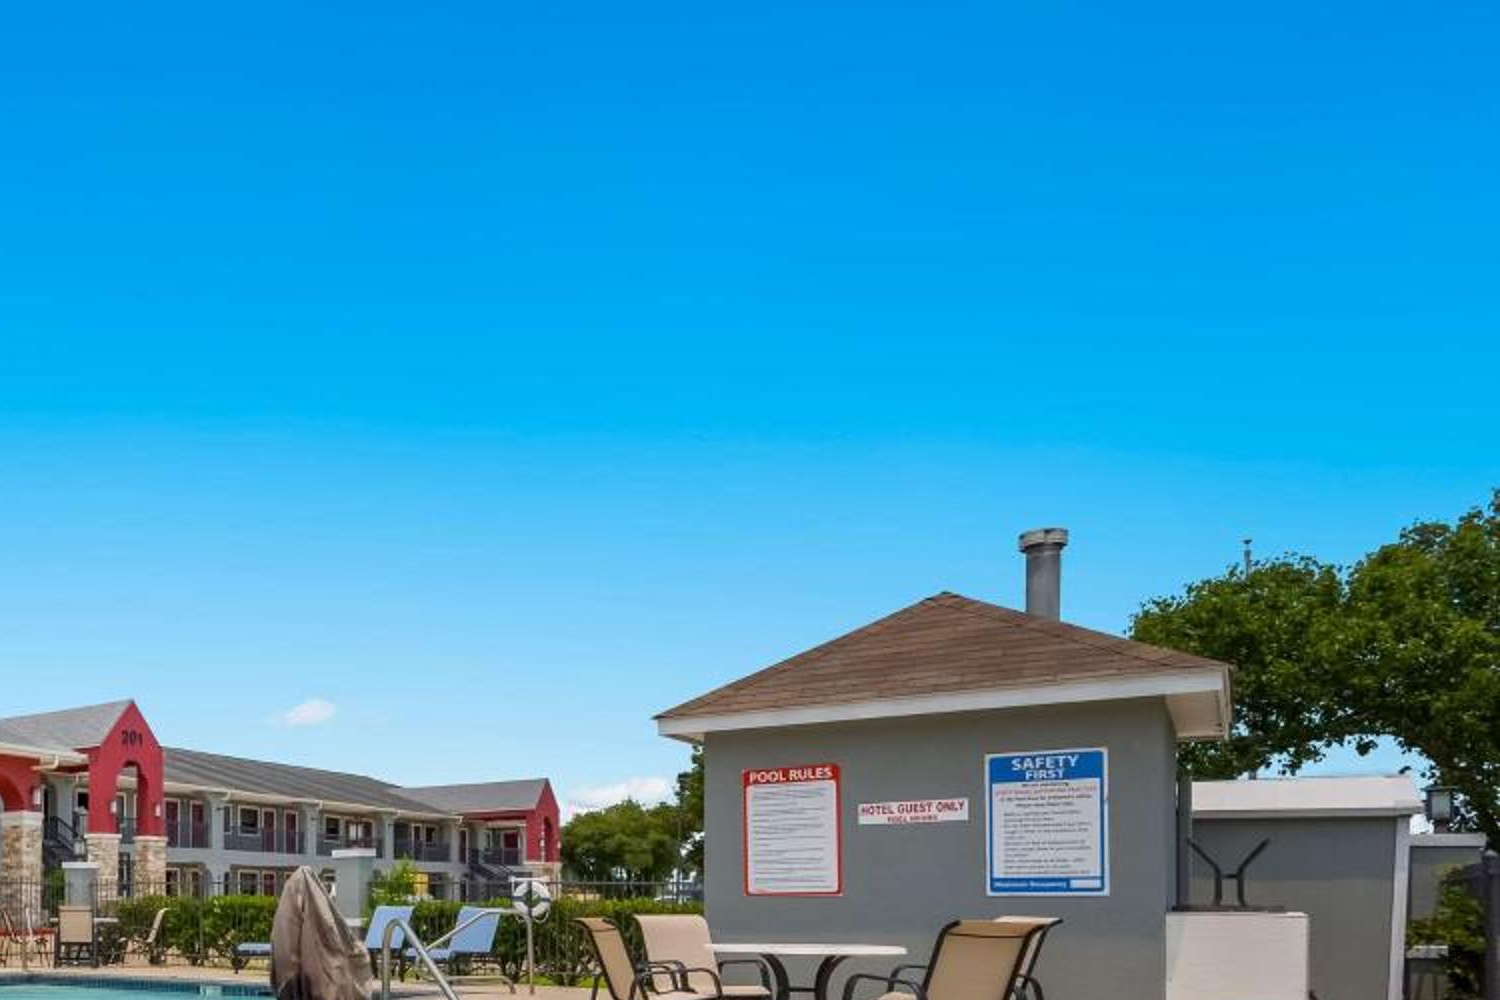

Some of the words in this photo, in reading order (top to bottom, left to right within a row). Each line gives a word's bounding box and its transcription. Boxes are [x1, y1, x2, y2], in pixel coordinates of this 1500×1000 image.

[121, 730, 143, 747] 201
[1012, 754, 1080, 771] SAFETY
[749, 770, 786, 783] POOL
[789, 767, 833, 781] RULES
[1025, 767, 1065, 780] FIRST
[861, 805, 894, 816] HOTEL
[897, 801, 933, 814] GUEST
[936, 800, 965, 812] ONLY
